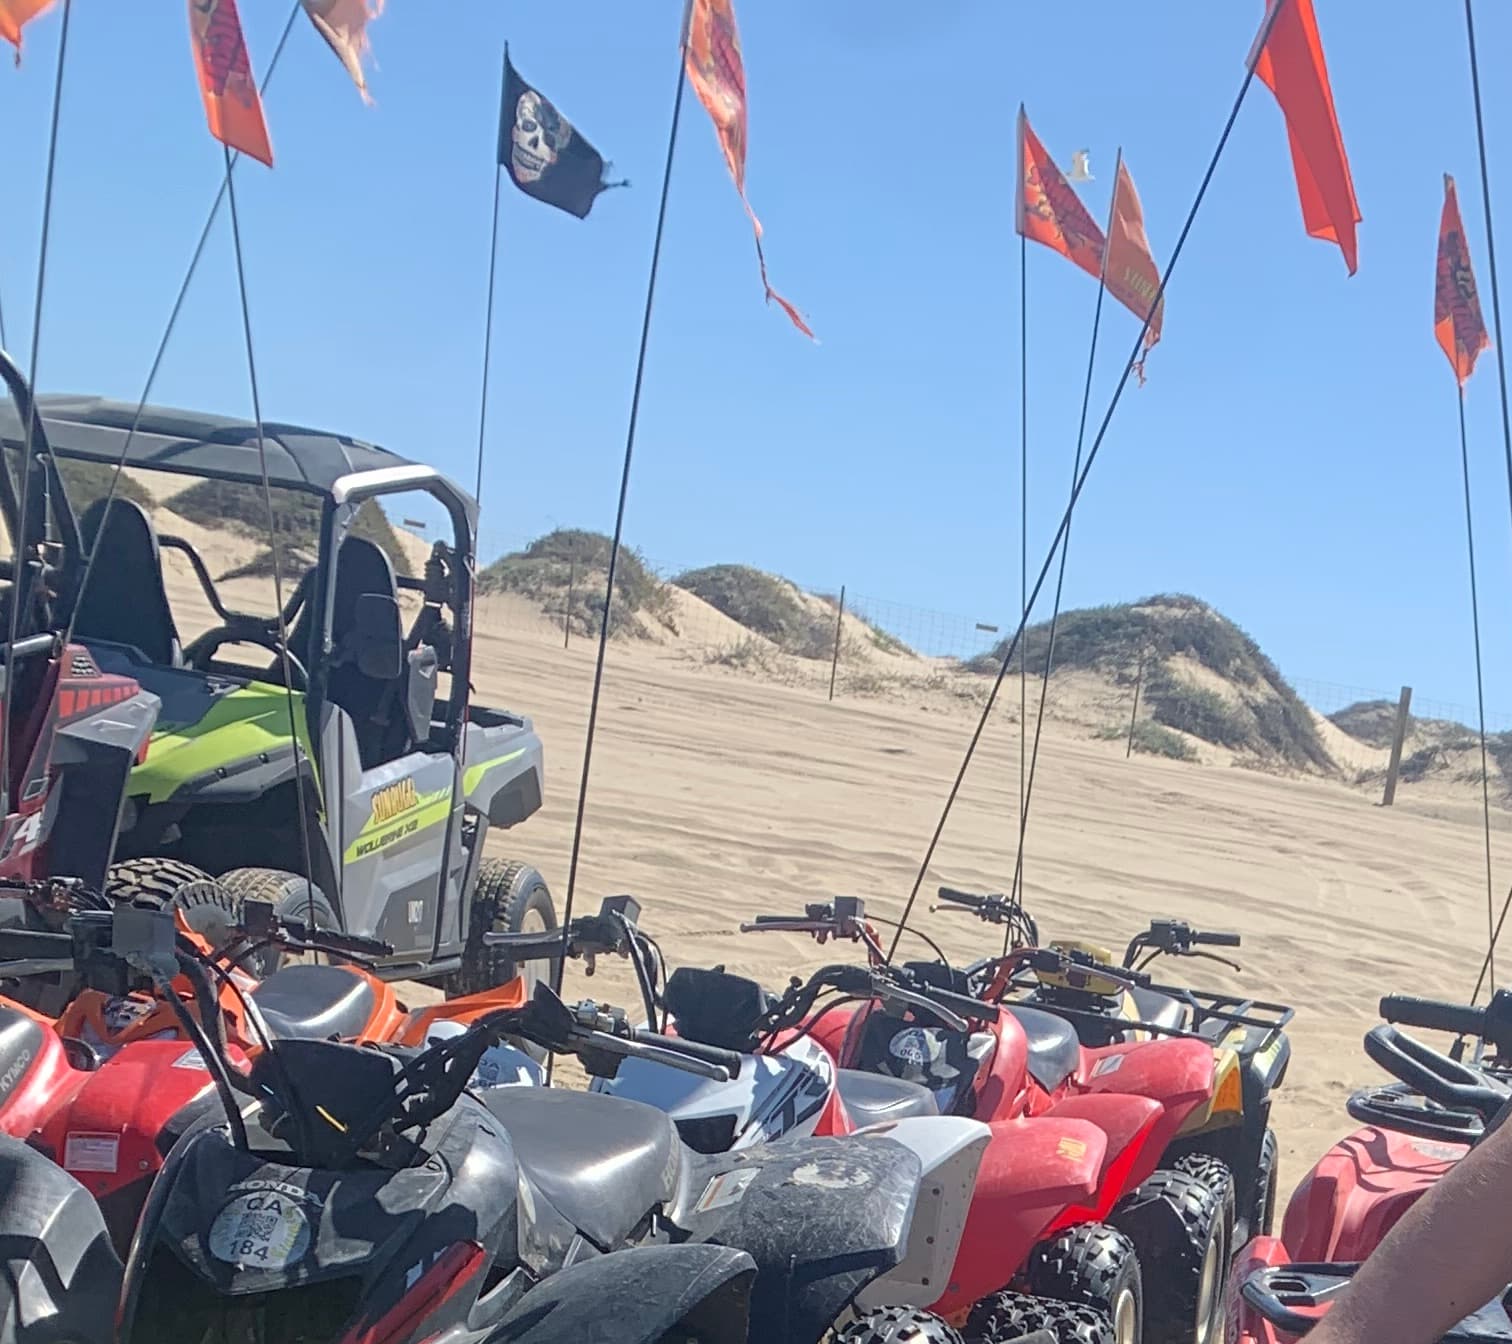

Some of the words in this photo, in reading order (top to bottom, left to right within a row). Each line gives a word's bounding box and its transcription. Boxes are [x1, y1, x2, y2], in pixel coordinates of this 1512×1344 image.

[0, 1049, 31, 1092] KYMCO
[228, 1179, 325, 1208] HONDA
[230, 1239, 269, 1261] 184
